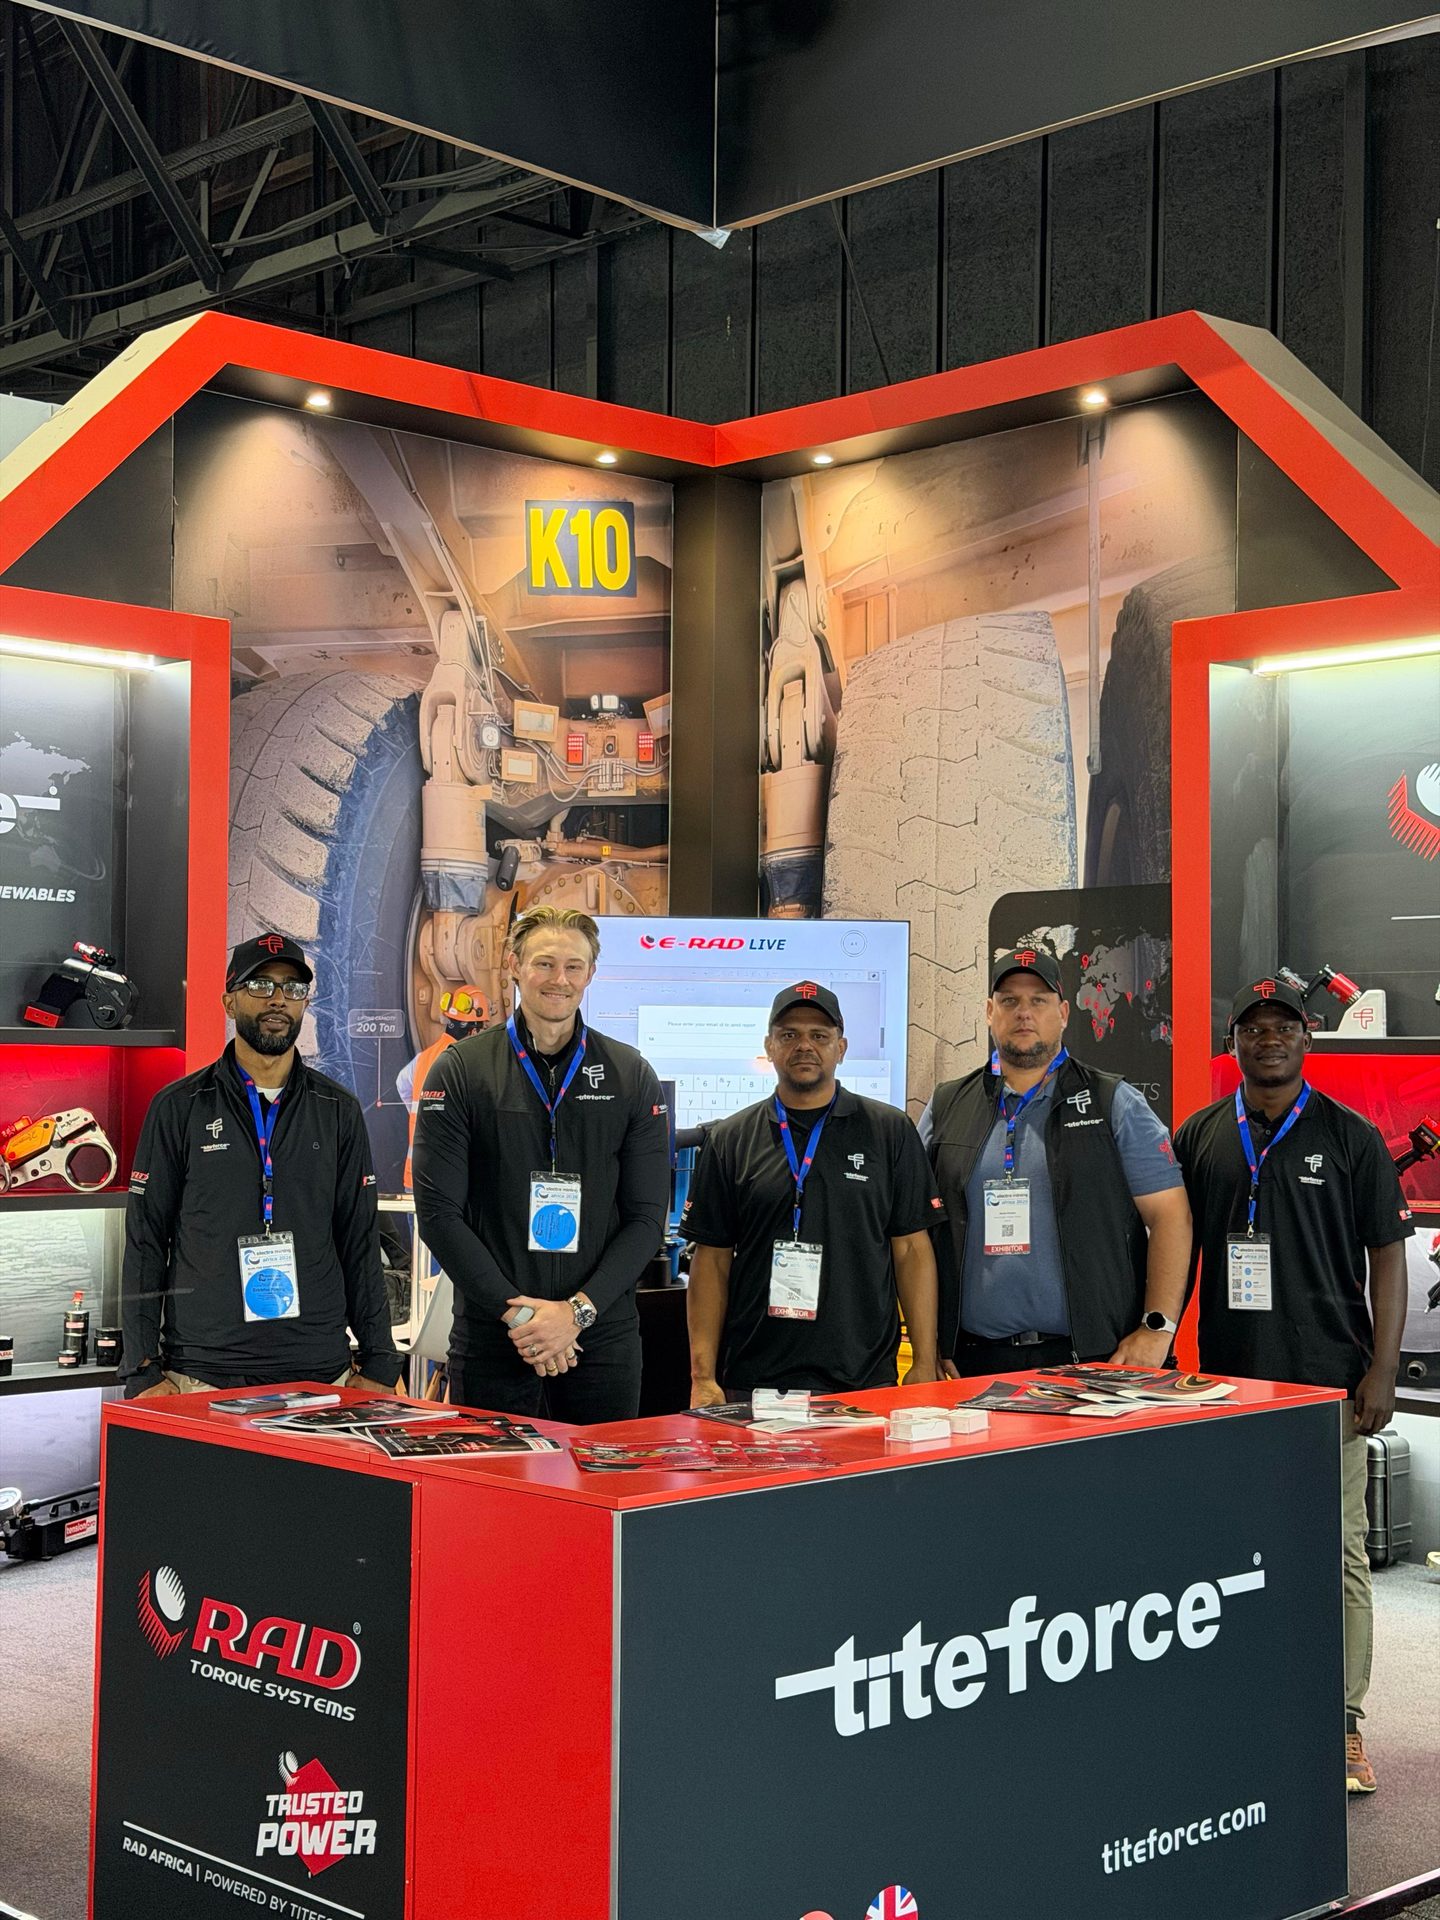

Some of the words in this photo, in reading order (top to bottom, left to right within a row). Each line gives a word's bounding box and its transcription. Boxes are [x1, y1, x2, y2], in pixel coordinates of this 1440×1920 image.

[529, 508, 631, 591] K10
[658, 937, 745, 950] E-RAD
[749, 939, 787, 951] LIVE
[356, 1022, 377, 1033] 200
[379, 1022, 396, 1033] Ton
[991, 1245, 1024, 1253] EXHIBITOR
[191, 1597, 362, 1690] RAD
[775, 1570, 1265, 1737] titeforce
[190, 1659, 263, 1694] TORQUE
[263, 1682, 357, 1722] SYSTEMS
[265, 1790, 364, 1817] TRUSTED
[256, 1819, 378, 1857] POWER
[1101, 1801, 1267, 1875] titeforce.com
[122, 1836, 148, 1857] RAD
[148, 1848, 193, 1877] AFRICA
[203, 1869, 267, 1905] POWERED
[269, 1895, 288, 1913] BY
